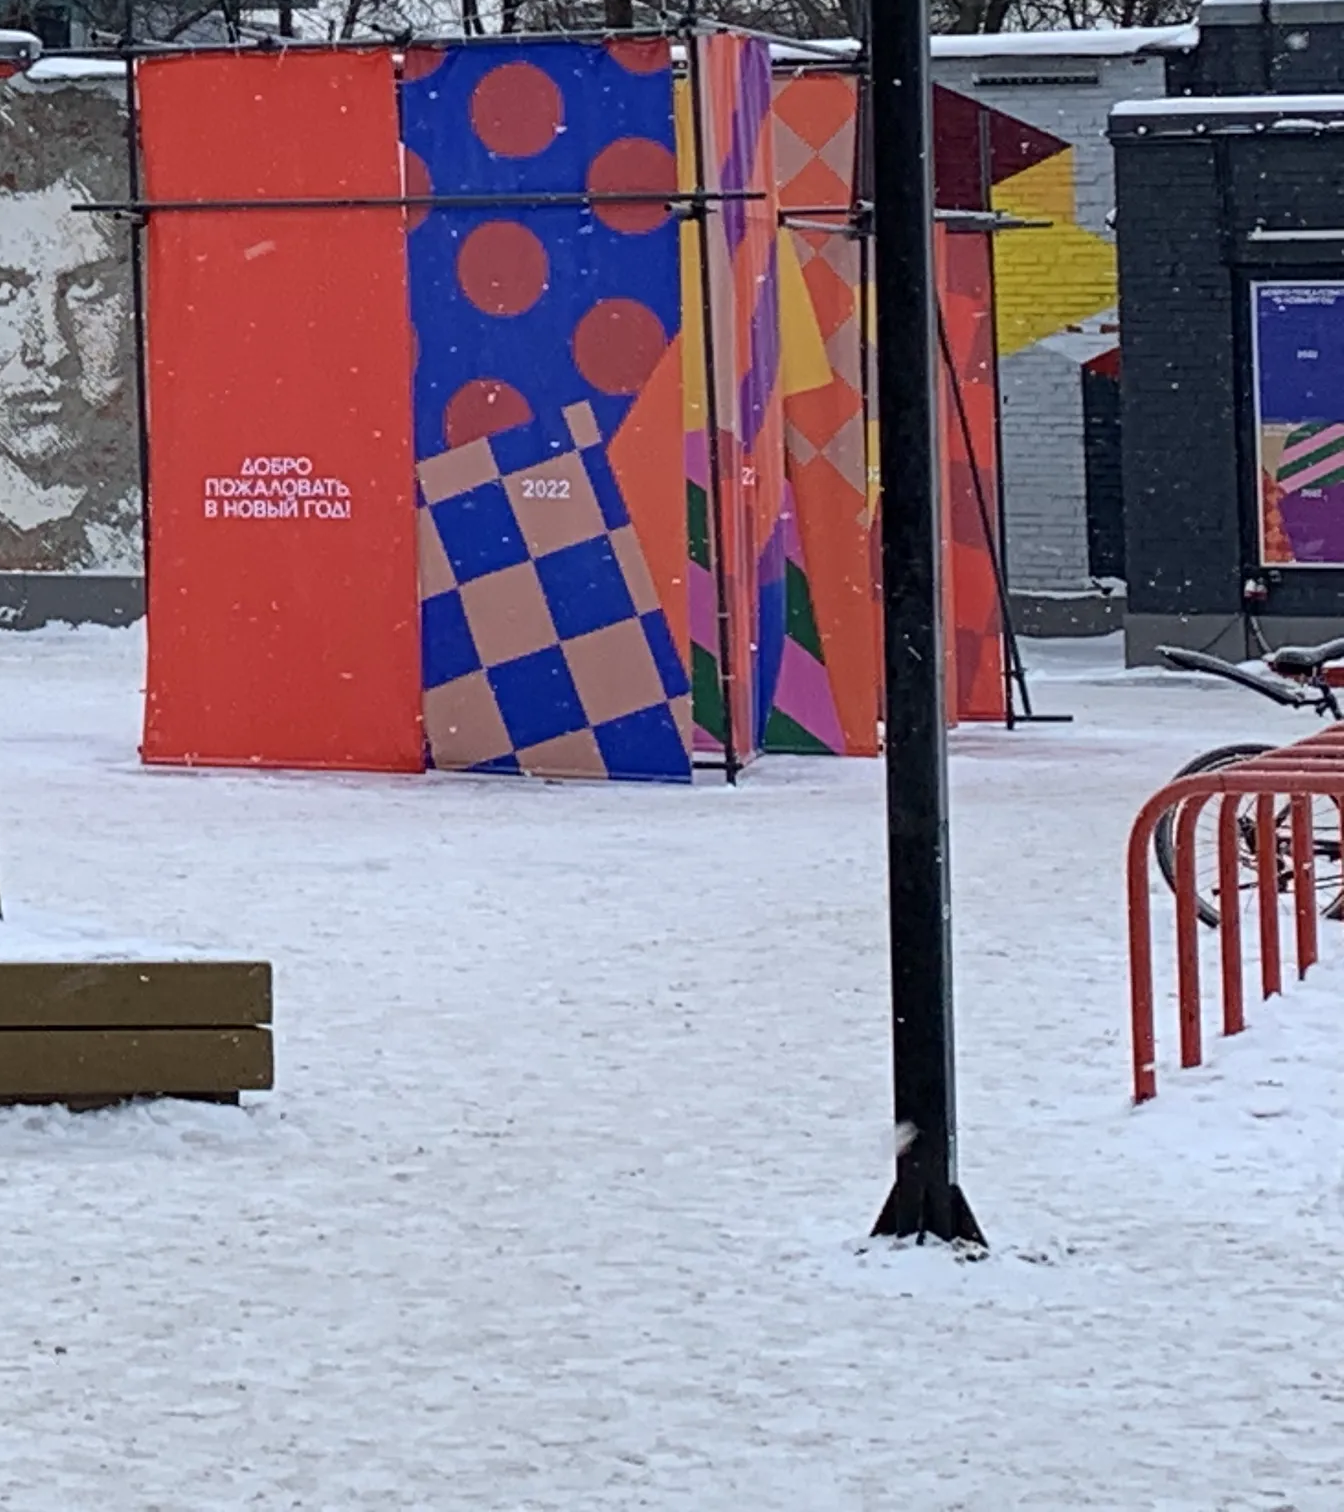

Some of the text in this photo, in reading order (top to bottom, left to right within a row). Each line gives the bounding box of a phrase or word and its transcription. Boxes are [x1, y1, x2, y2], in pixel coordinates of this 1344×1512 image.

[241, 457, 312, 475] ДОБРО
[205, 479, 351, 497] ПОЖАЛОВАТЬ
[521, 479, 570, 498] 2022
[205, 495, 351, 518] В НОВЫЙ ГОД!
